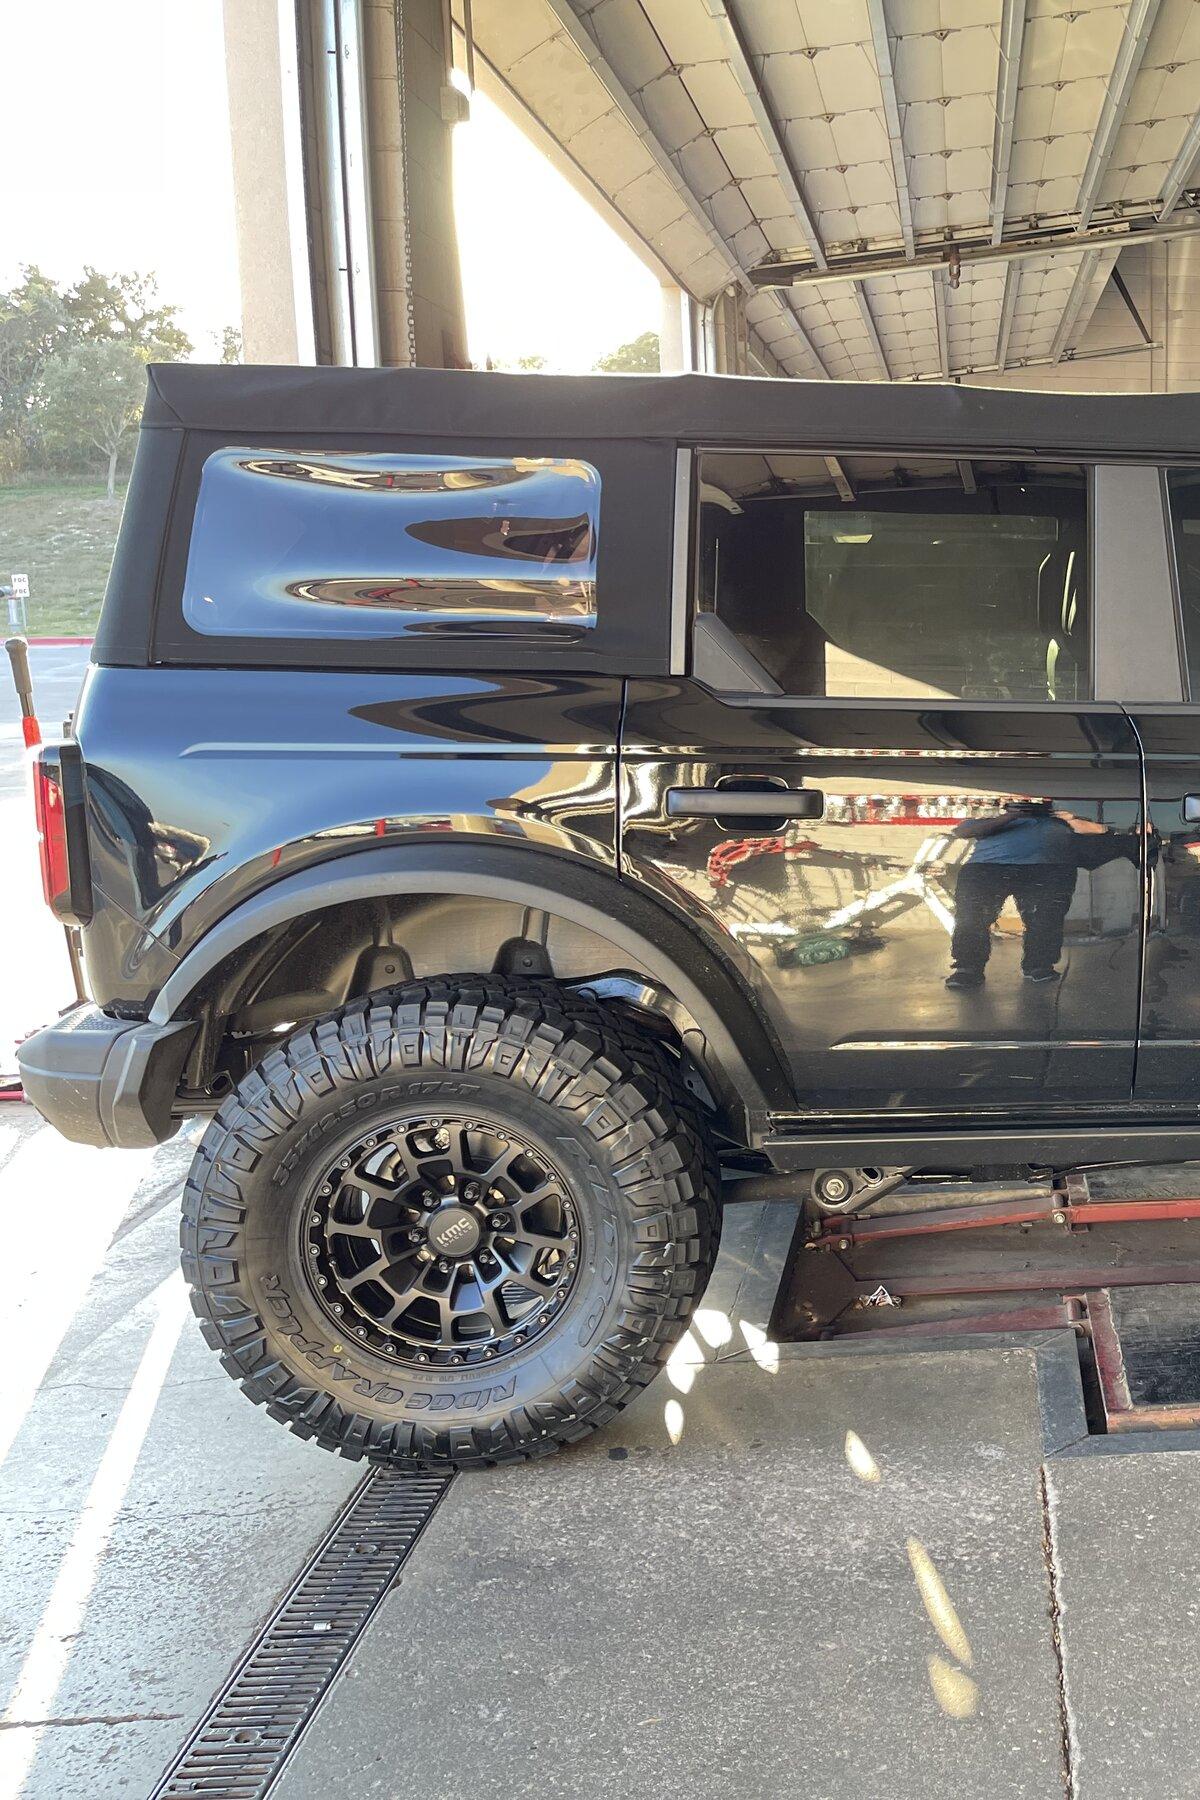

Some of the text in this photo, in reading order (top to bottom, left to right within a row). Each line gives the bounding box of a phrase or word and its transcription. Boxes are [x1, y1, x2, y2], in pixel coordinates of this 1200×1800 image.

[436, 1217, 470, 1245] KMC
[260, 1274, 517, 1412] RIDGE GRAPPLER
